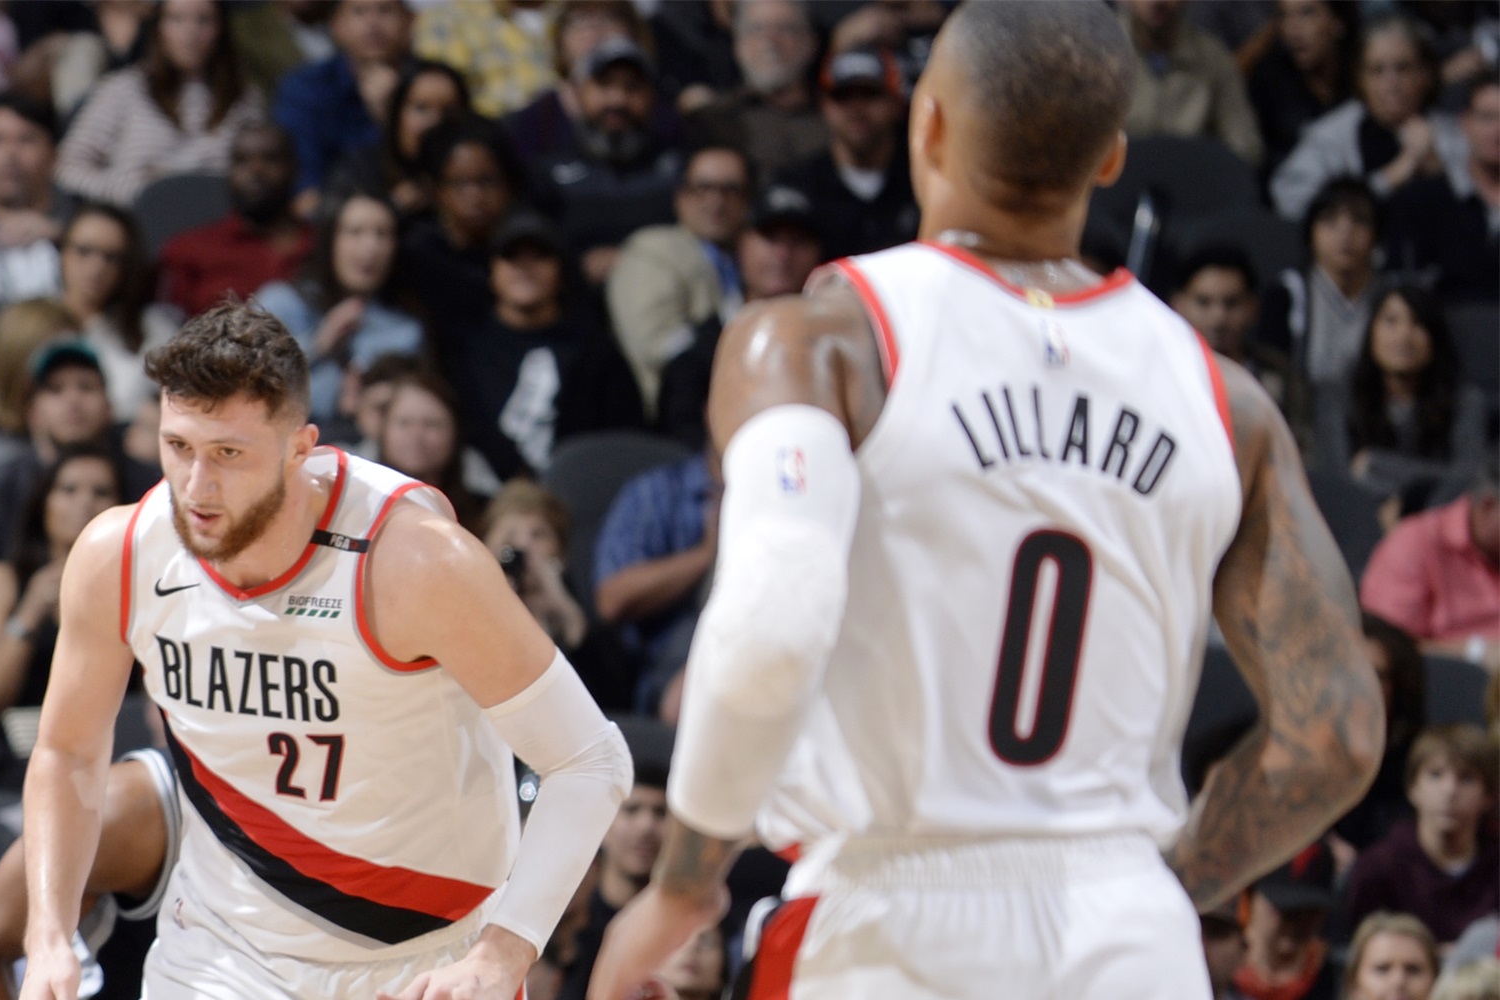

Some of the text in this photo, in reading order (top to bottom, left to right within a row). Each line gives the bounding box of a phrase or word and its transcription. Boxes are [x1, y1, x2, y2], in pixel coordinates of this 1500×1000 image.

[951, 385, 1177, 495] LILLARD
[287, 595, 343, 609] BIOFREEZE
[154, 633, 340, 722] BLAZERS
[987, 530, 1094, 767] 0
[267, 731, 346, 802] 27
